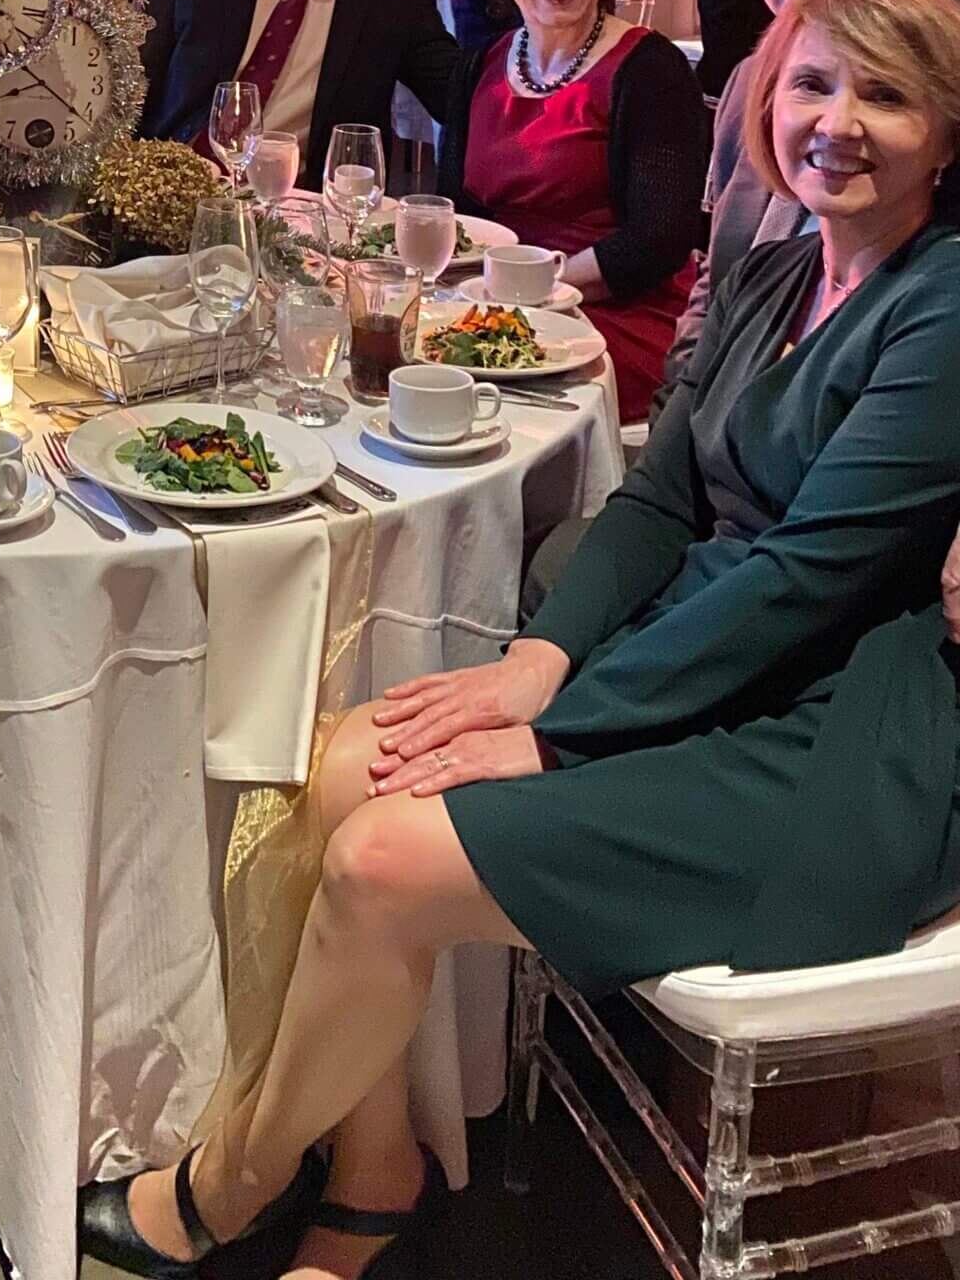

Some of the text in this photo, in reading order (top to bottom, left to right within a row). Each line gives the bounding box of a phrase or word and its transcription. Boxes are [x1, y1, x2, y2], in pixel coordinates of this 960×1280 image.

[71, 26, 77, 47] 1
[87, 47, 100, 68] 2
[91, 75, 104, 96] 3
[5, 121, 17, 140] 7
[63, 120, 76, 142] 5
